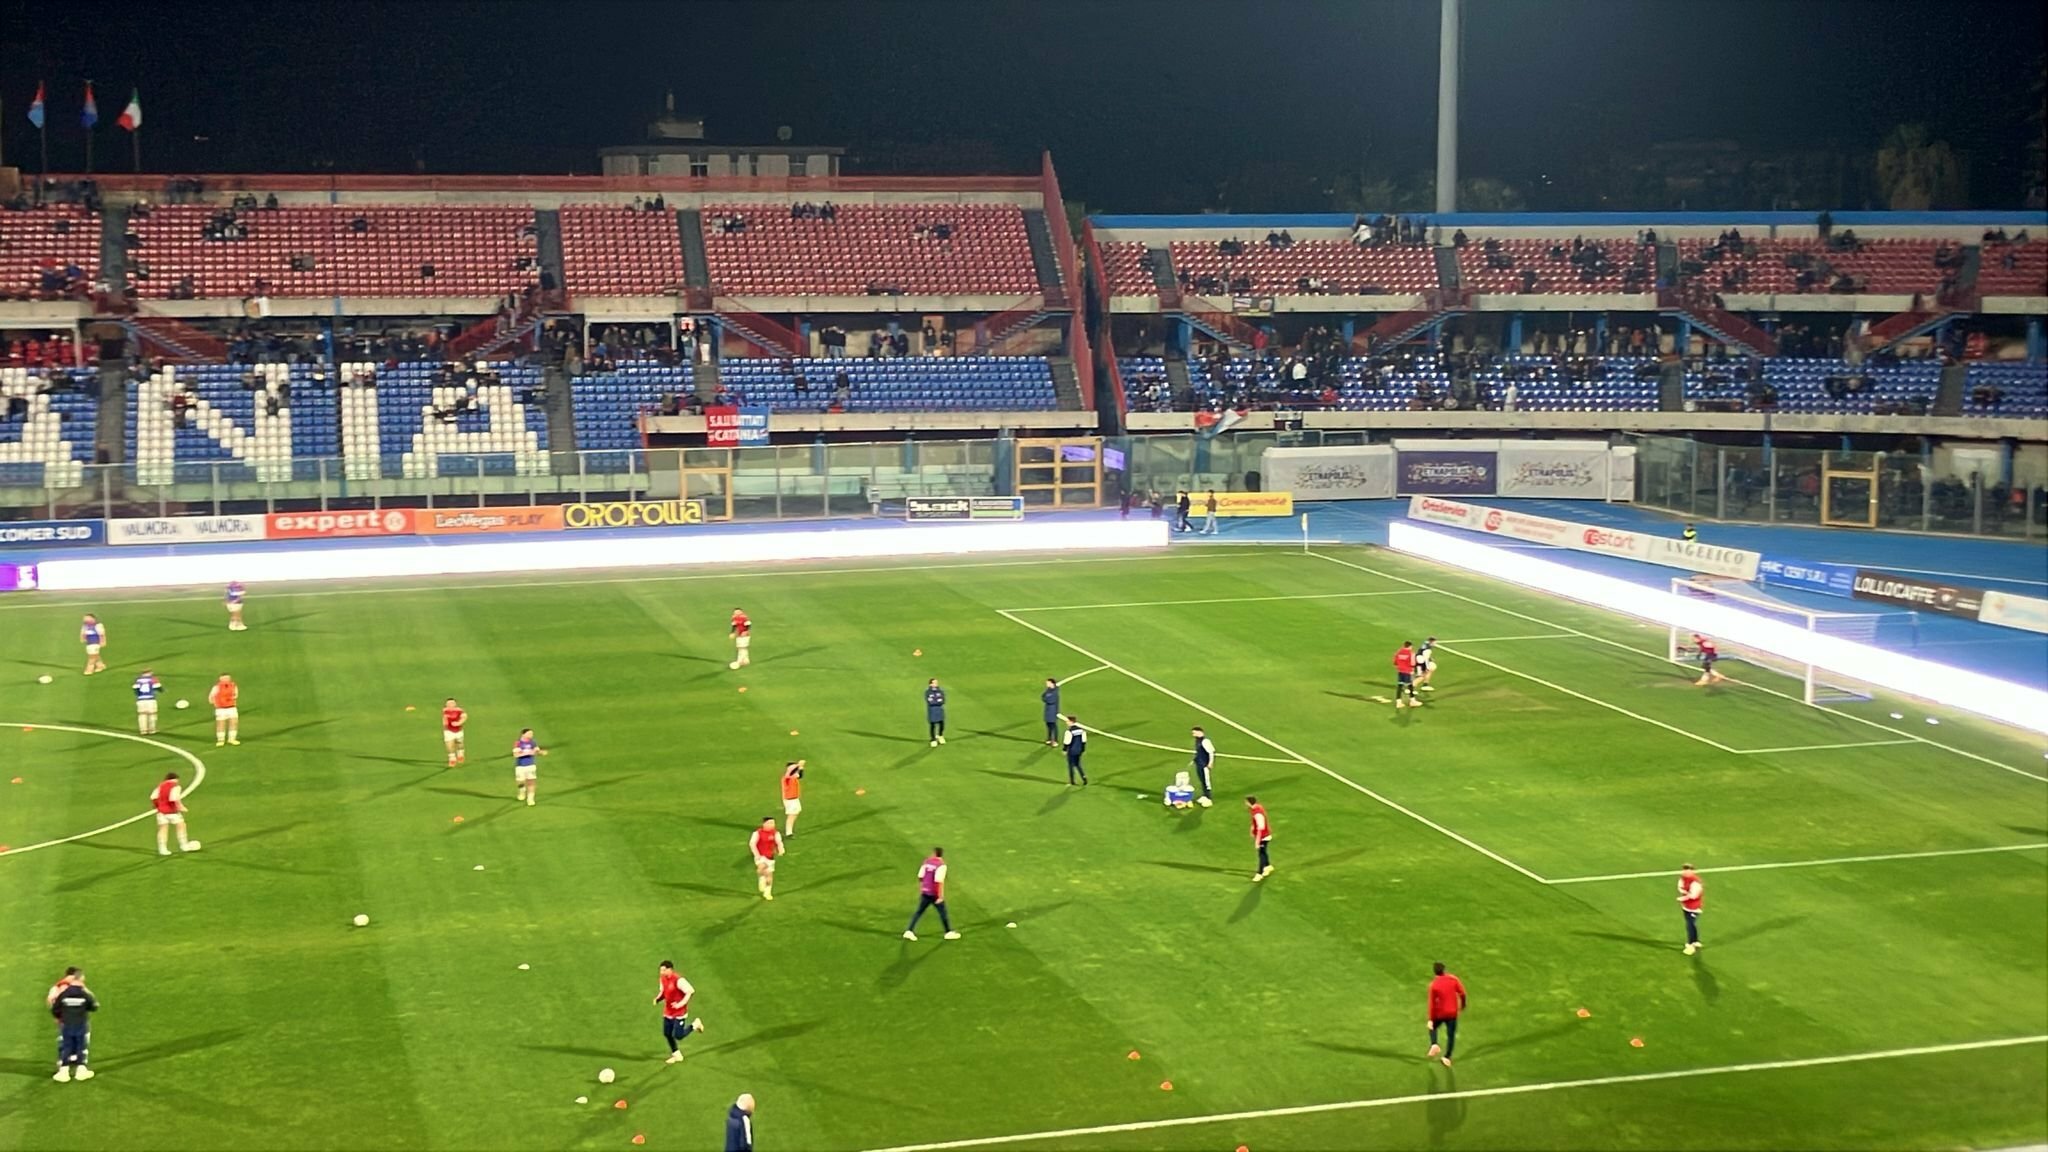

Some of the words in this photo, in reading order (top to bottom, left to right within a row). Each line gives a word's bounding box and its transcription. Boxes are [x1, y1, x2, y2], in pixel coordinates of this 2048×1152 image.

[275, 510, 381, 532] expert
[435, 513, 505, 529] LeoVegas
[508, 514, 544, 526] PLAY
[56, 526, 92, 539] SUD
[1583, 529, 1635, 550] restart
[1666, 540, 1744, 564] ANGELICO
